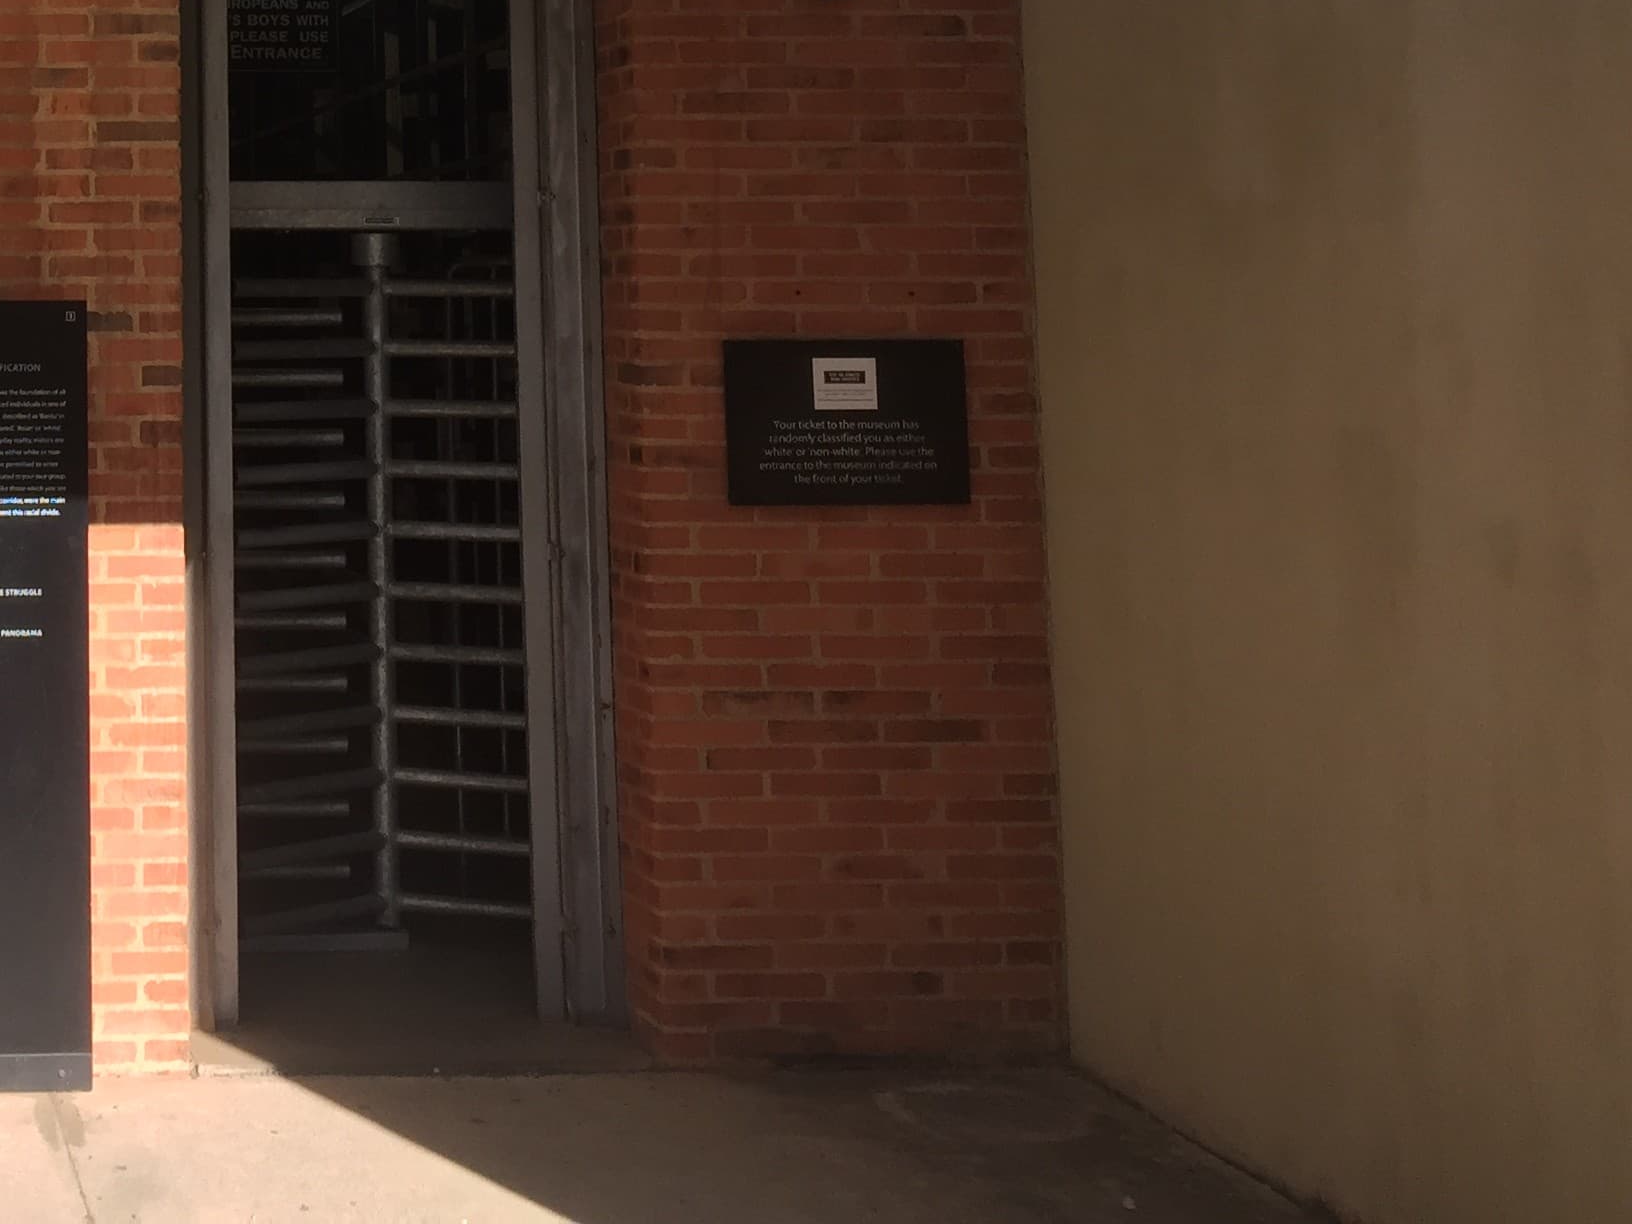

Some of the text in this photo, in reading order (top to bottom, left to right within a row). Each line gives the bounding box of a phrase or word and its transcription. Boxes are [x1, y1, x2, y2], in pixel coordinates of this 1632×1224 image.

[248, 14, 290, 26] BOYS
[296, 15, 329, 26] WITH
[230, 31, 329, 42] PLEASE USE
[231, 44, 321, 59] ENTRANCE
[774, 420, 919, 429] Your ticket to the museum has
[769, 433, 816, 444] randomly
[817, 433, 862, 443] classified
[864, 435, 881, 443] you
[918, 447, 935, 456] the
[759, 462, 801, 471] entrance
[803, 461, 814, 470] to
[816, 460, 831, 470] the
[833, 462, 876, 470] museum
[794, 475, 810, 483] the
[5, 589, 42, 597] STRUGGLE
[1, 629, 43, 637] PANORAMA
